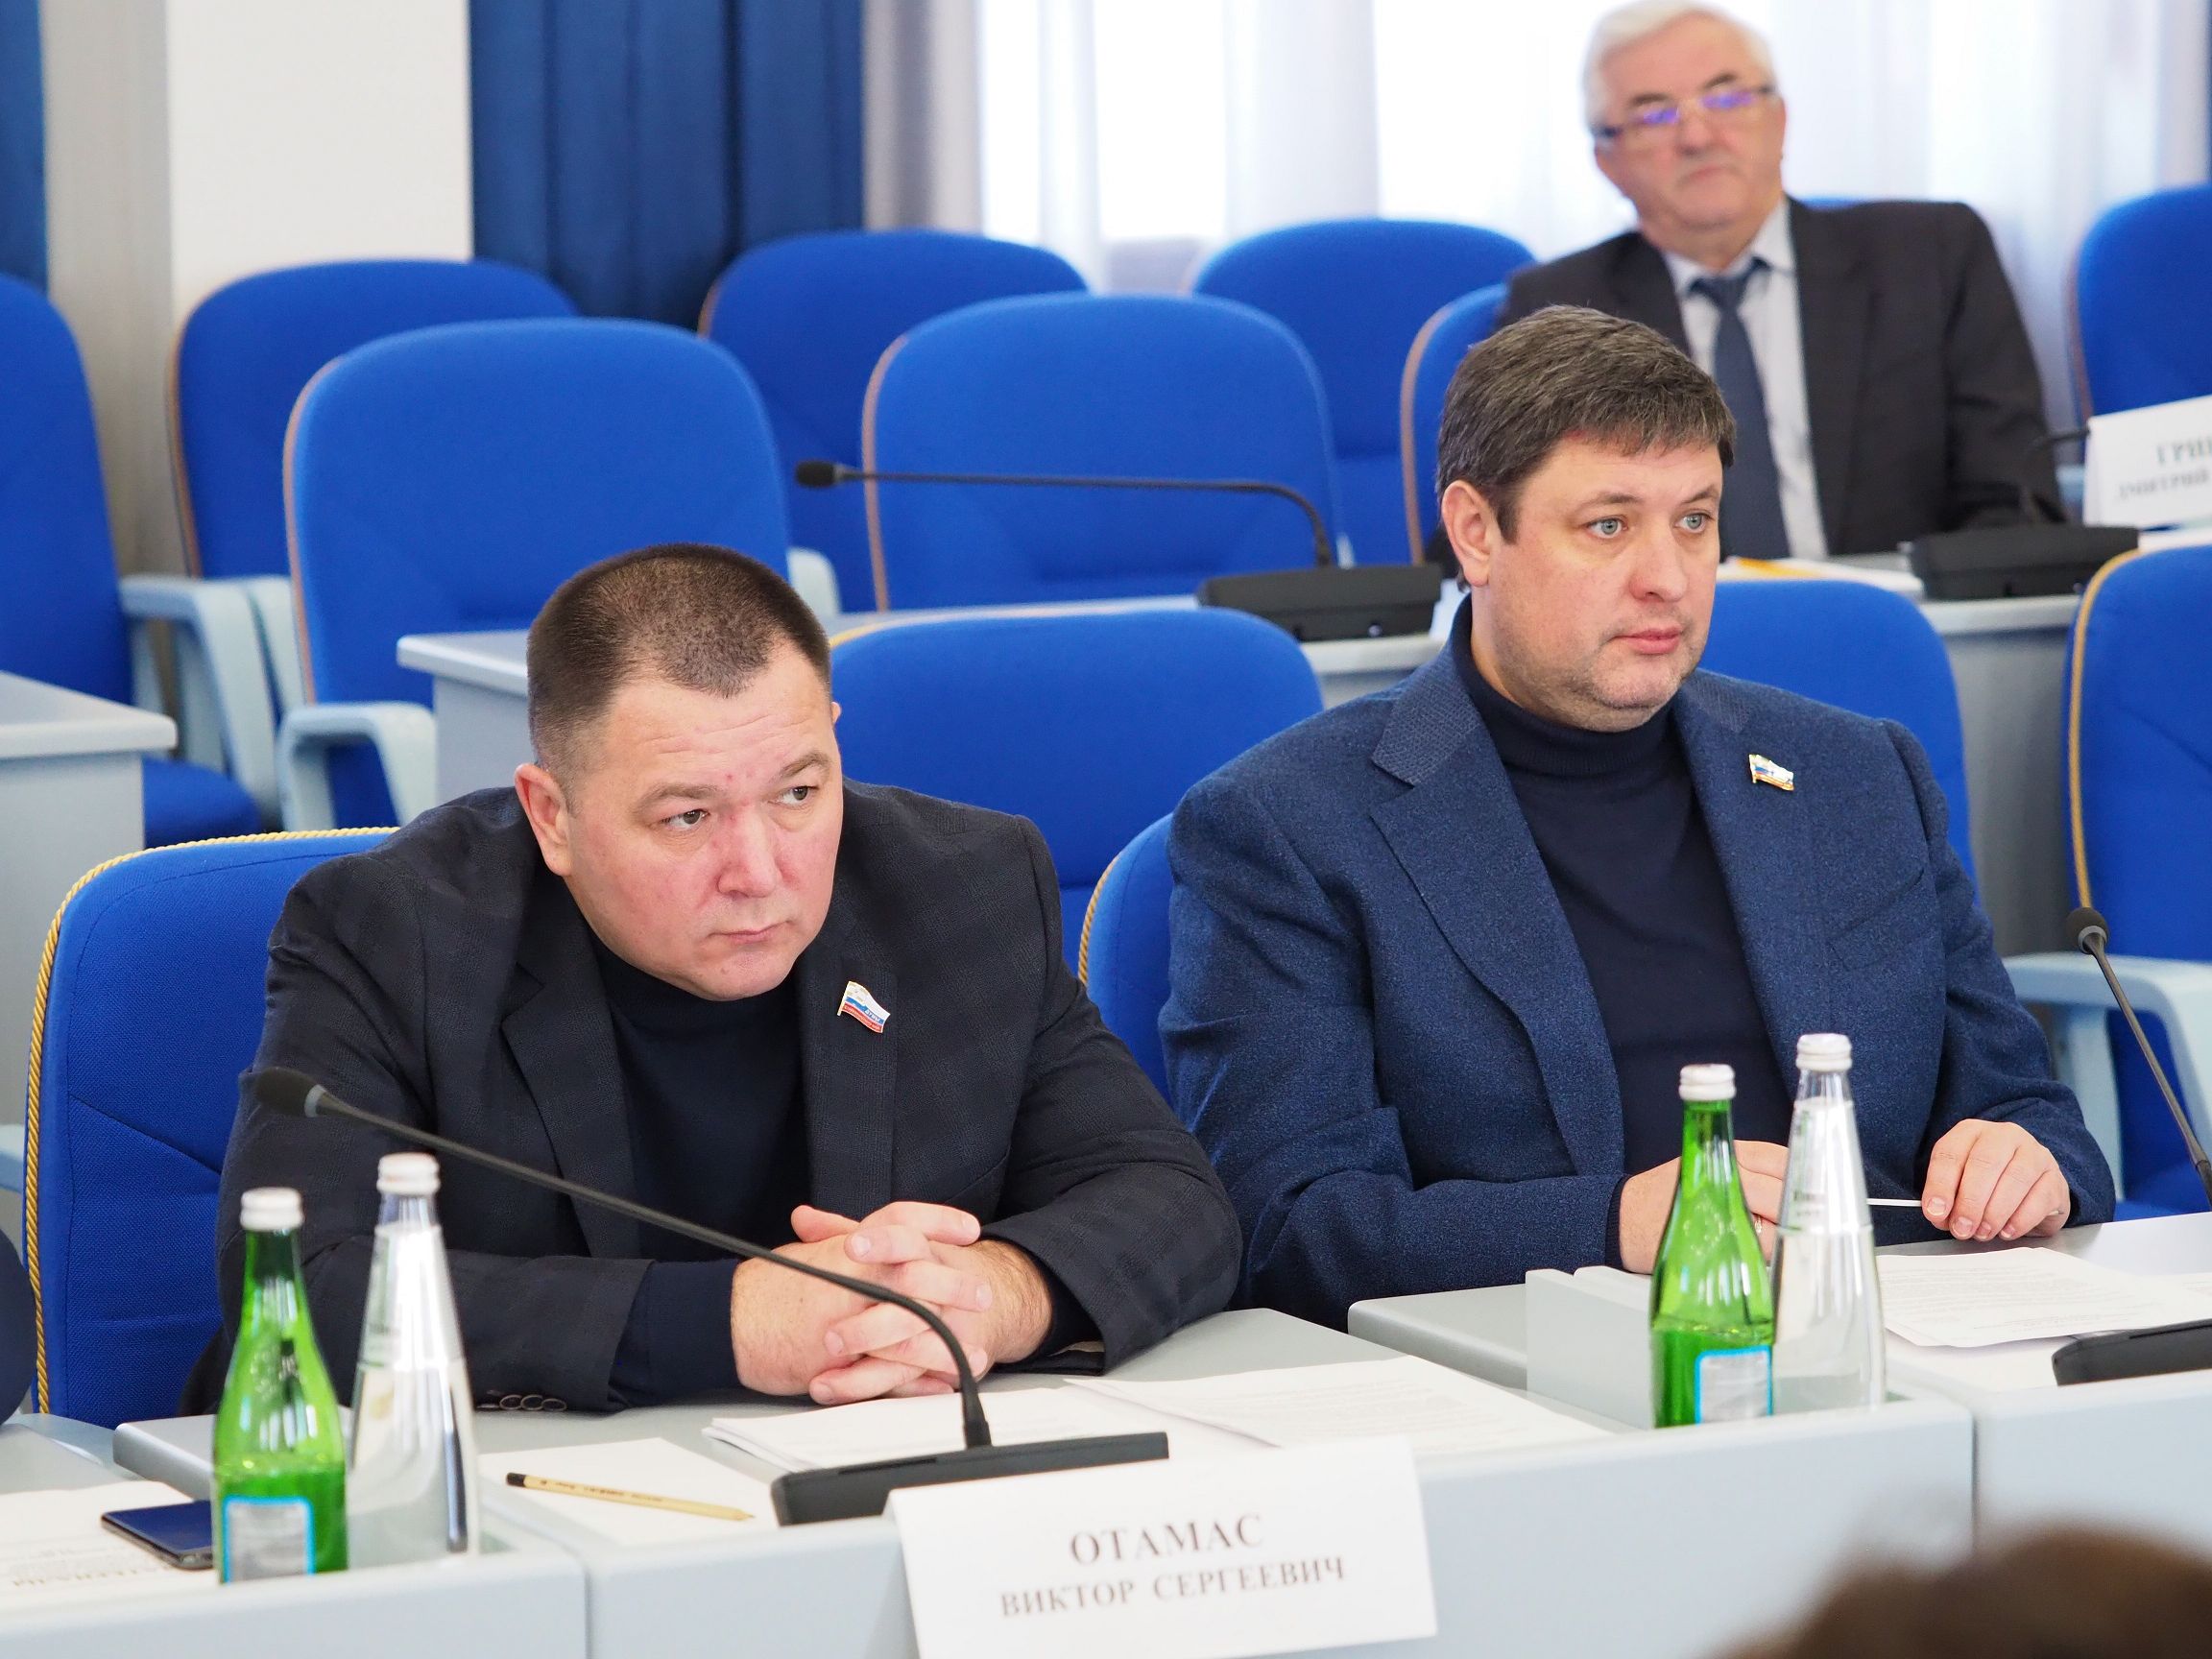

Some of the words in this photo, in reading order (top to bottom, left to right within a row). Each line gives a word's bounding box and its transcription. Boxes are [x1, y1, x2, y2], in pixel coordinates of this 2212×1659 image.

[1070, 1514, 1262, 1564] ОТАМАС
[1000, 1580, 1135, 1617] ВИКТОР
[1154, 1556, 1344, 1600] СЕРГЕЕВИЧ
